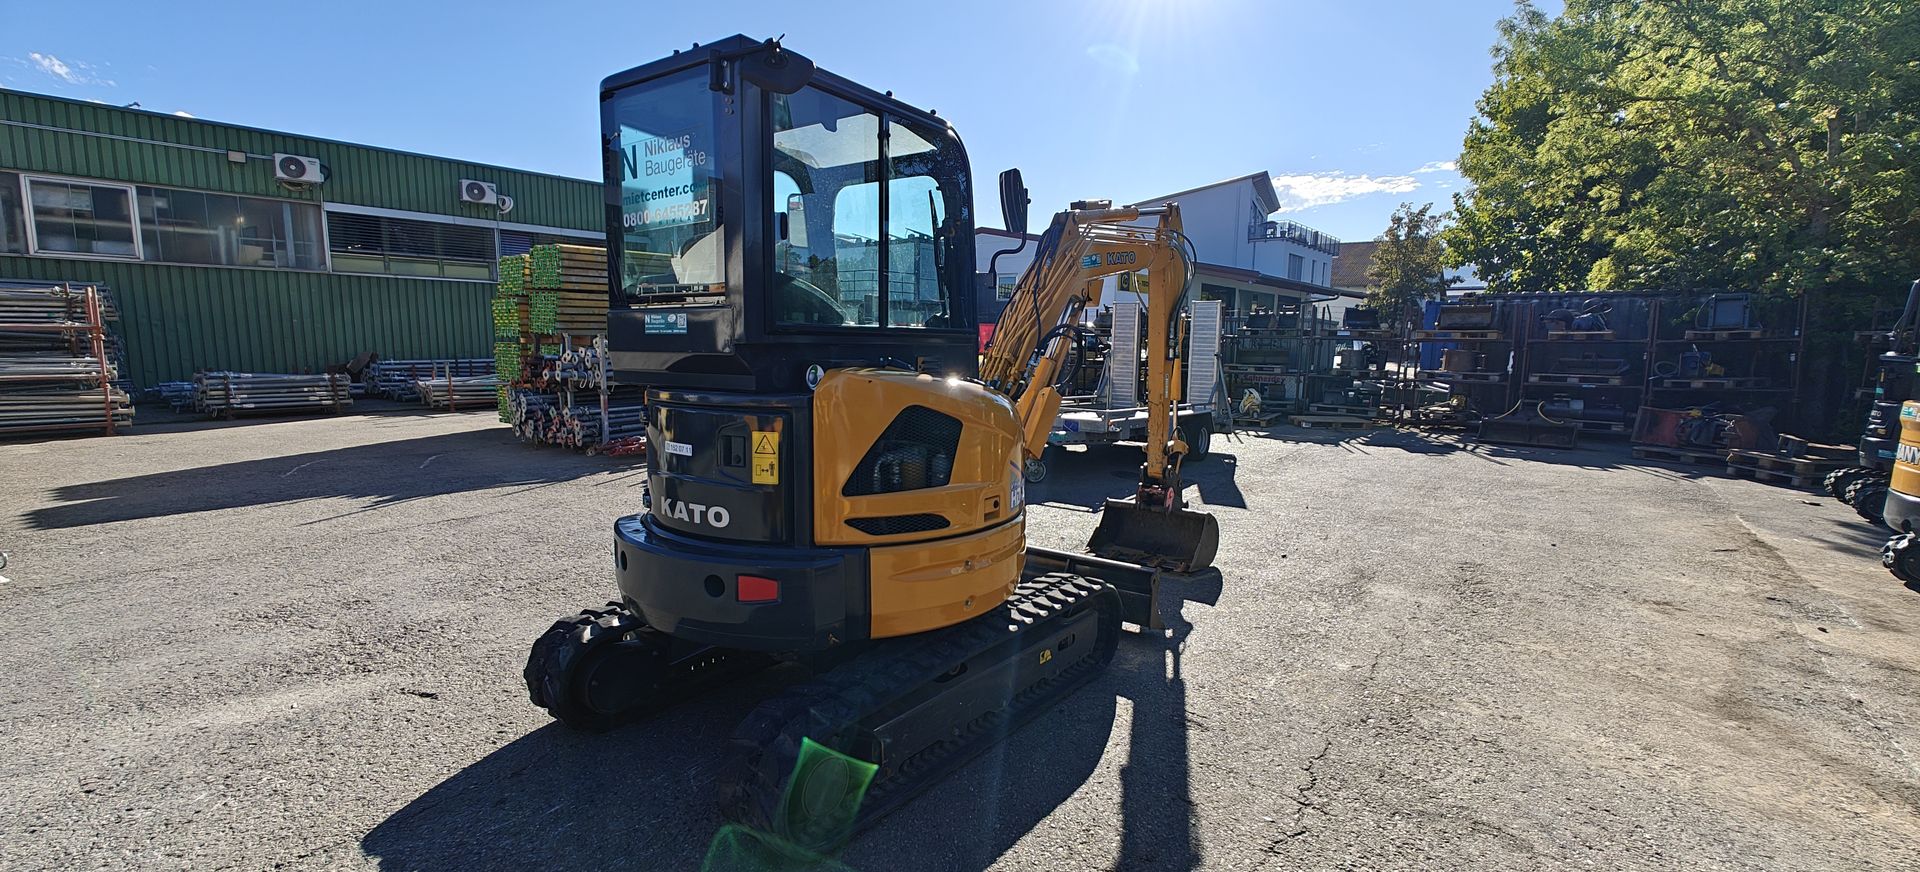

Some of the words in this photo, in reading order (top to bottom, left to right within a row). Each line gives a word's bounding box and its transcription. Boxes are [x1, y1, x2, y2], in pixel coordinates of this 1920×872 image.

[644, 134, 691, 157] Niklaus
[621, 145, 638, 181] N
[645, 149, 706, 176] Baugeräte
[623, 209, 650, 228] 0800
[1106, 250, 1136, 265] KATO
[660, 496, 730, 528] KATO
